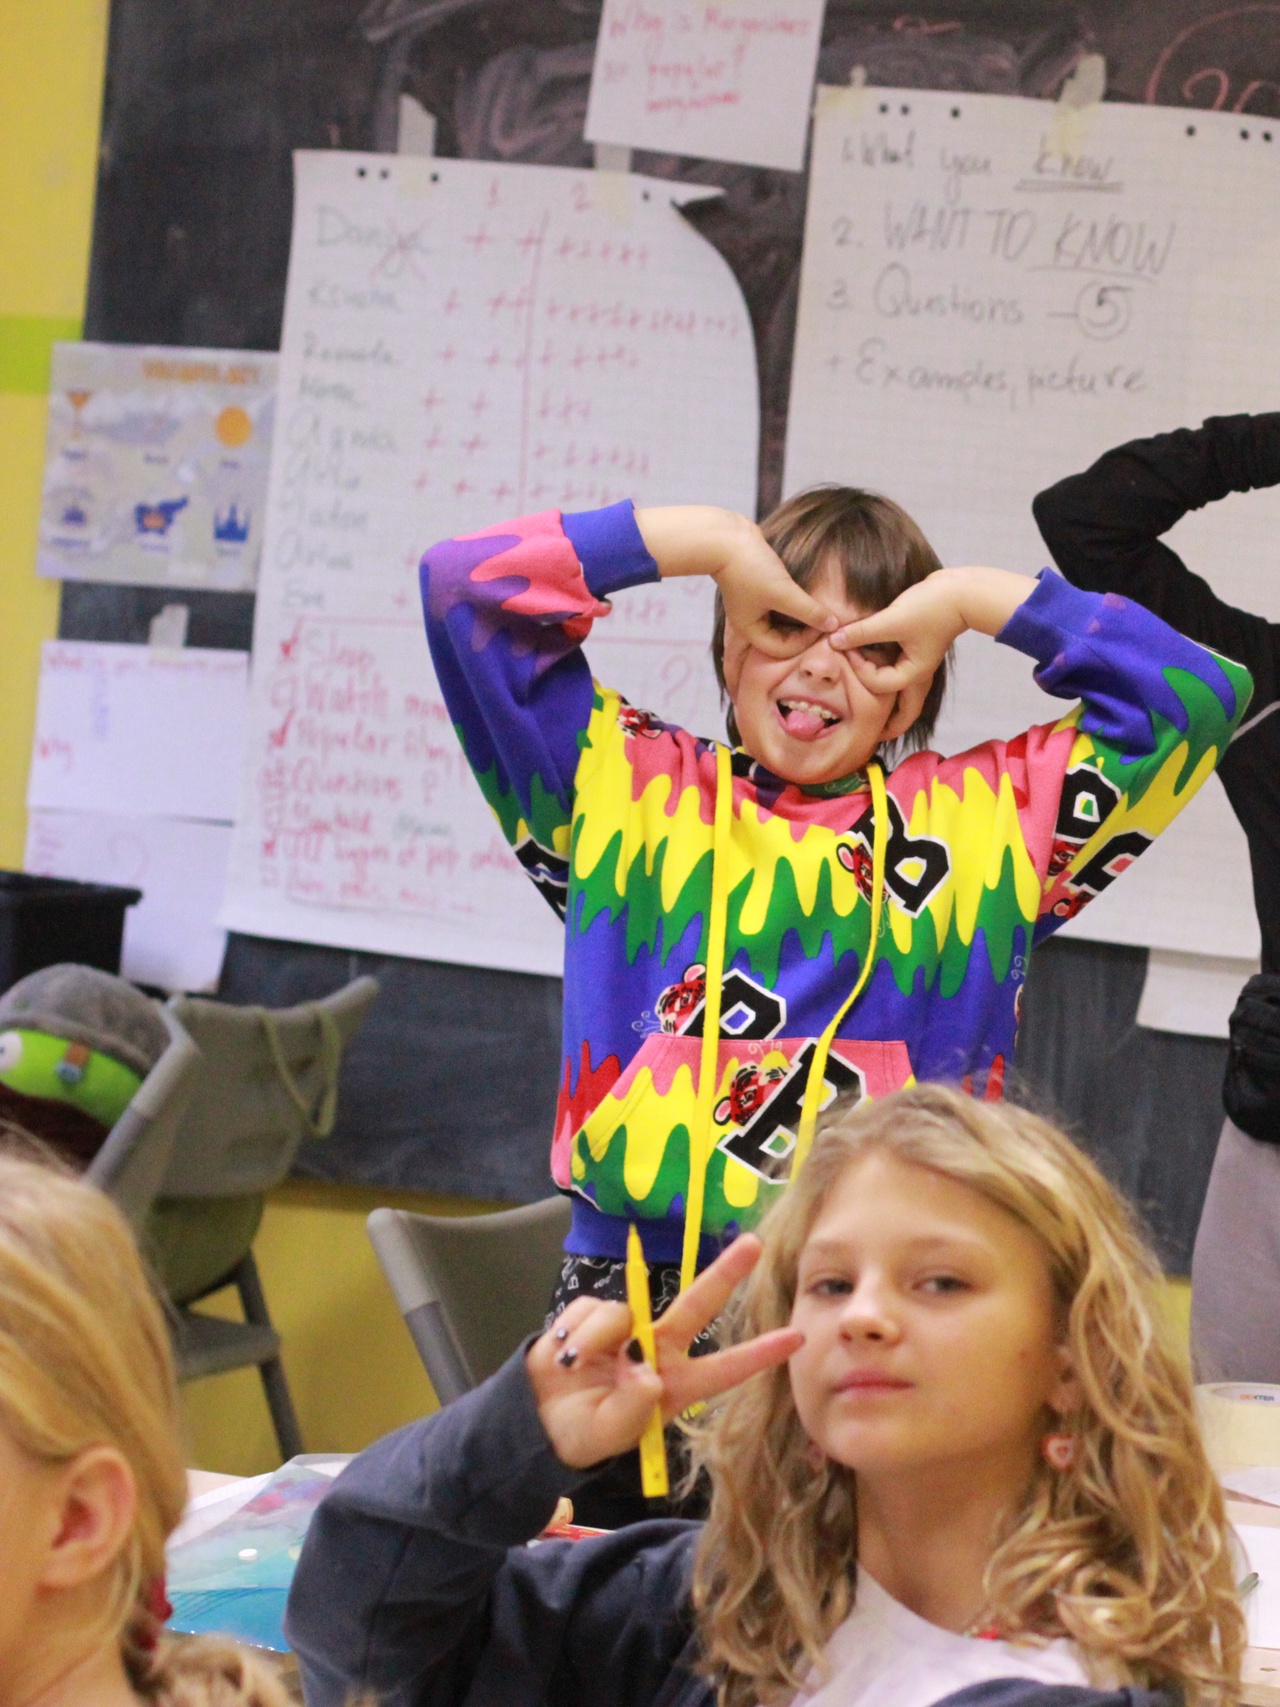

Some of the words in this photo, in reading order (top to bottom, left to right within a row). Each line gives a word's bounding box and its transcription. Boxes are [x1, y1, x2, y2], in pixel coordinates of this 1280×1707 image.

[884, 202, 972, 250] WANT
[986, 207, 1036, 262] TO
[1053, 211, 1176, 275] KNOW
